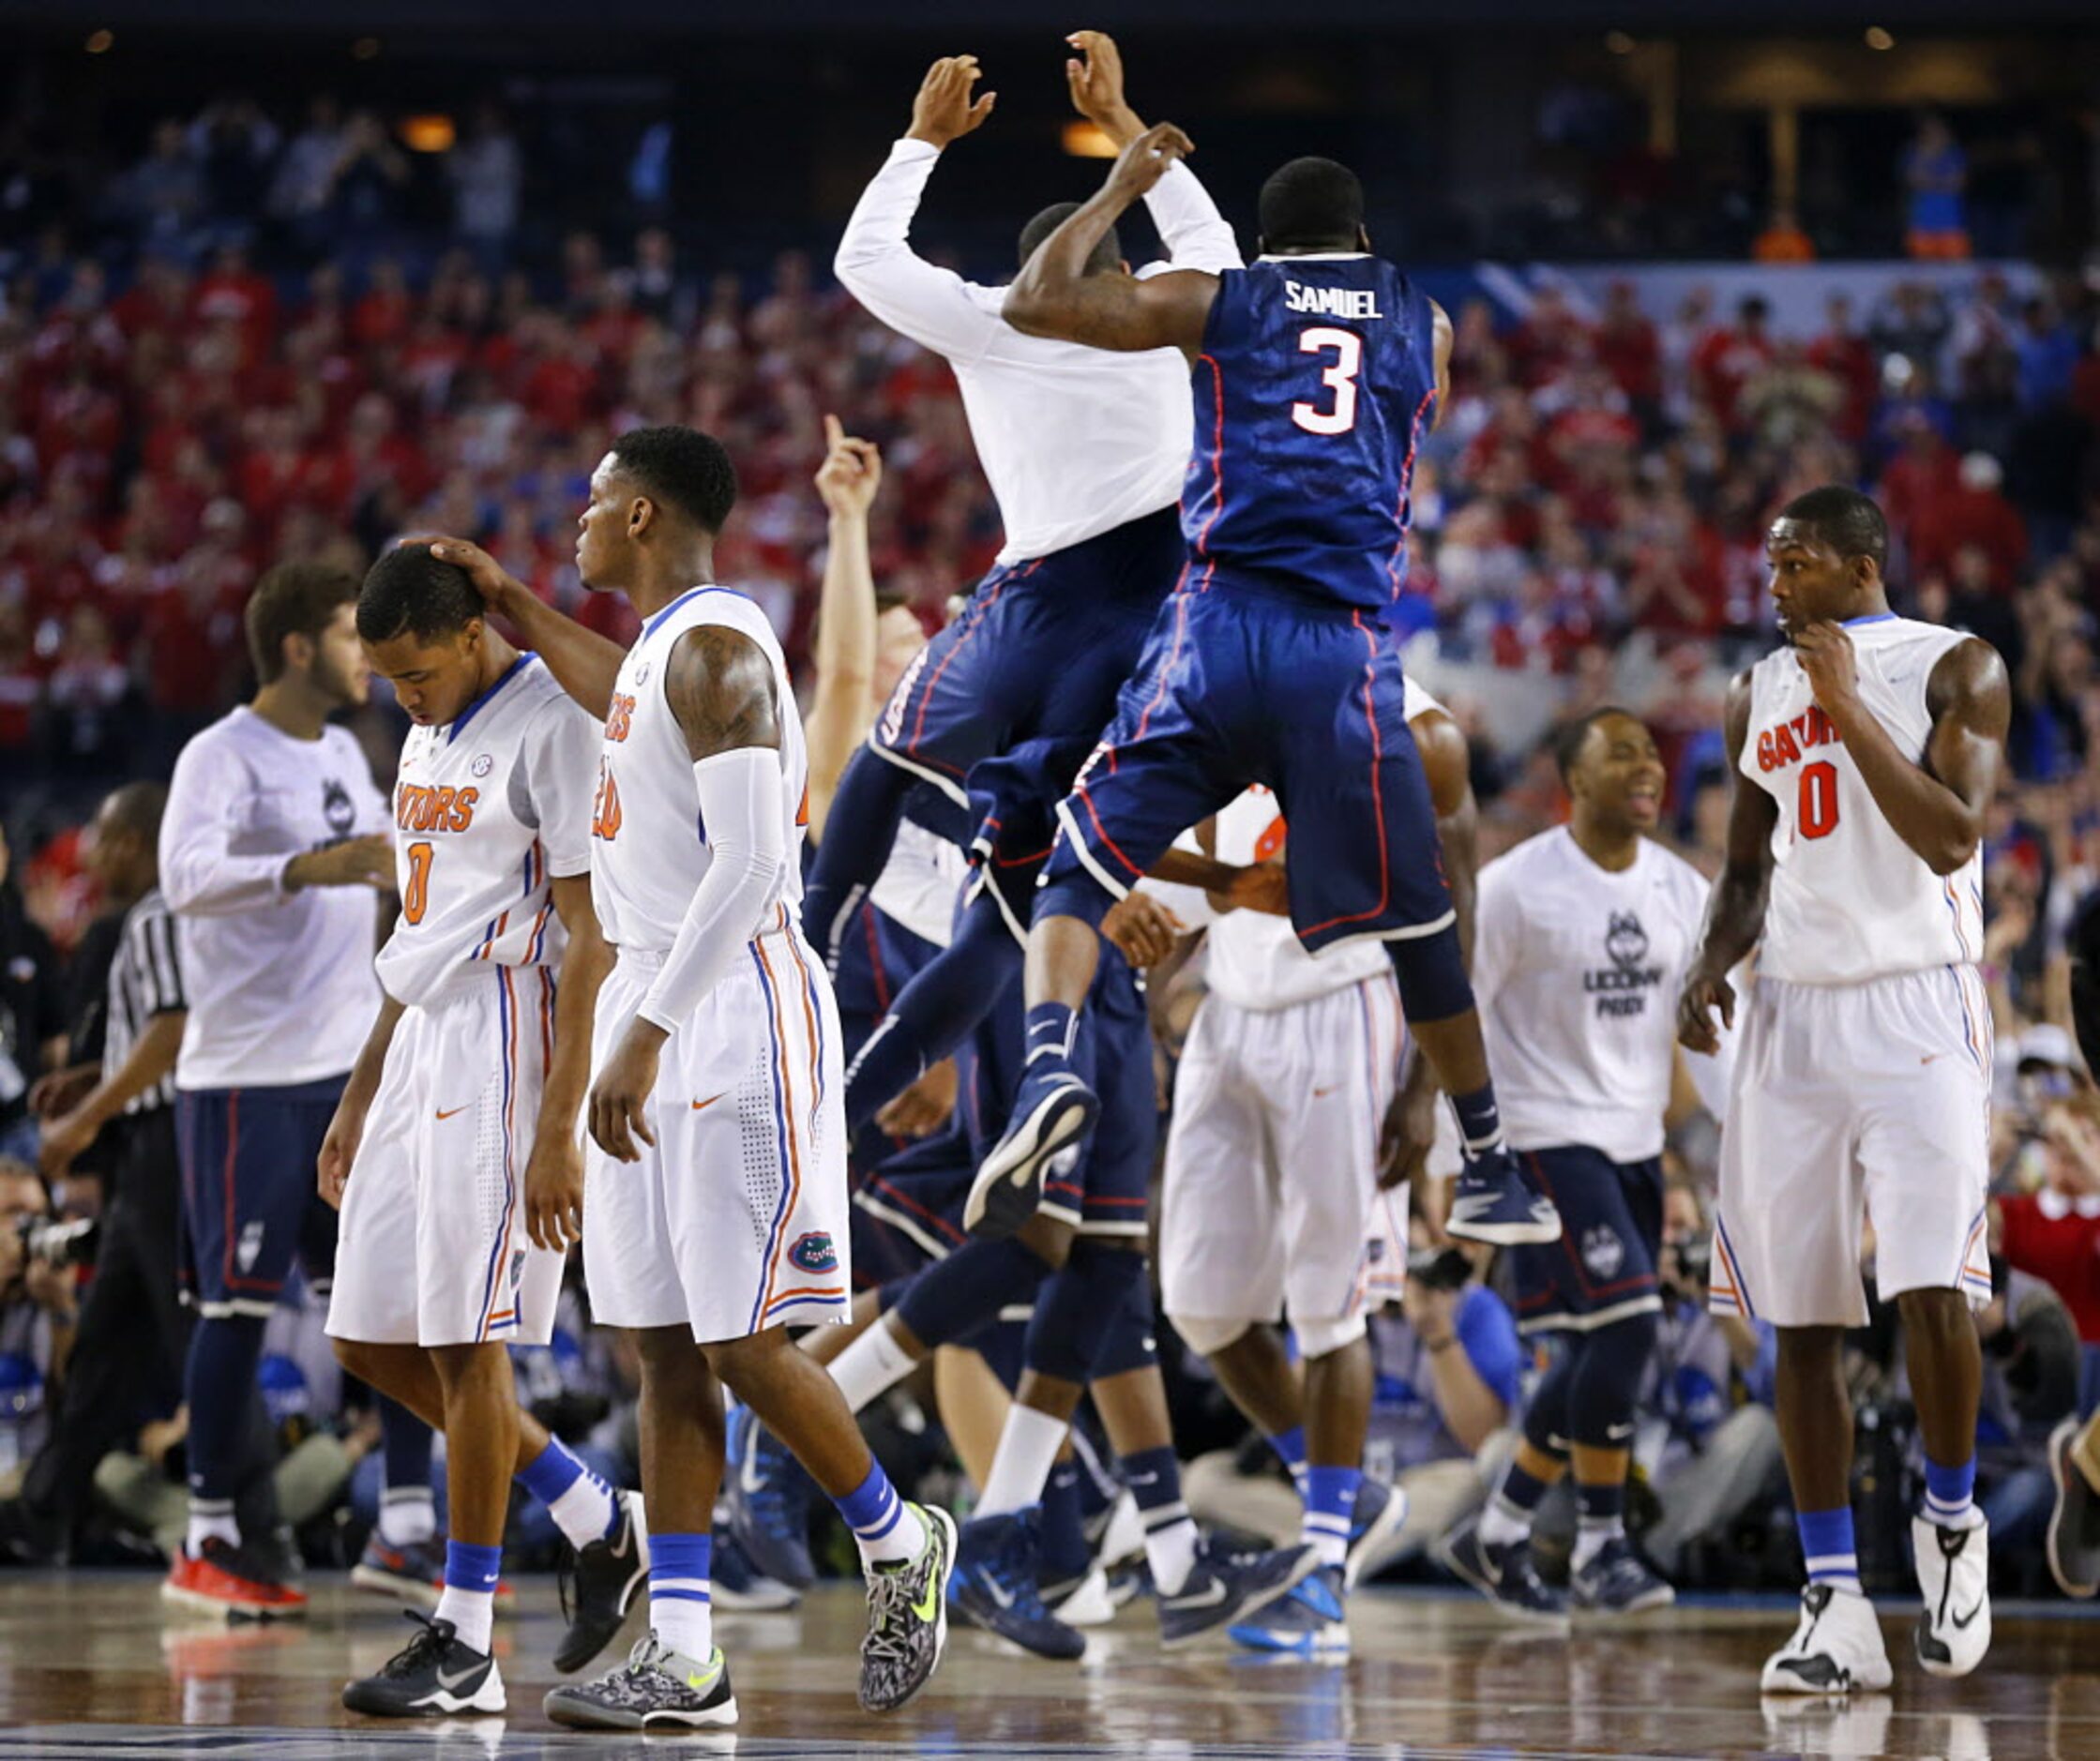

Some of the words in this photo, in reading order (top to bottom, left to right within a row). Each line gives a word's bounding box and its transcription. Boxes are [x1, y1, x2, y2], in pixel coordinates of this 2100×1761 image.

[1285, 280, 1383, 319] SAMUEL
[1292, 326, 1362, 435] 3
[404, 842, 434, 926] 0
